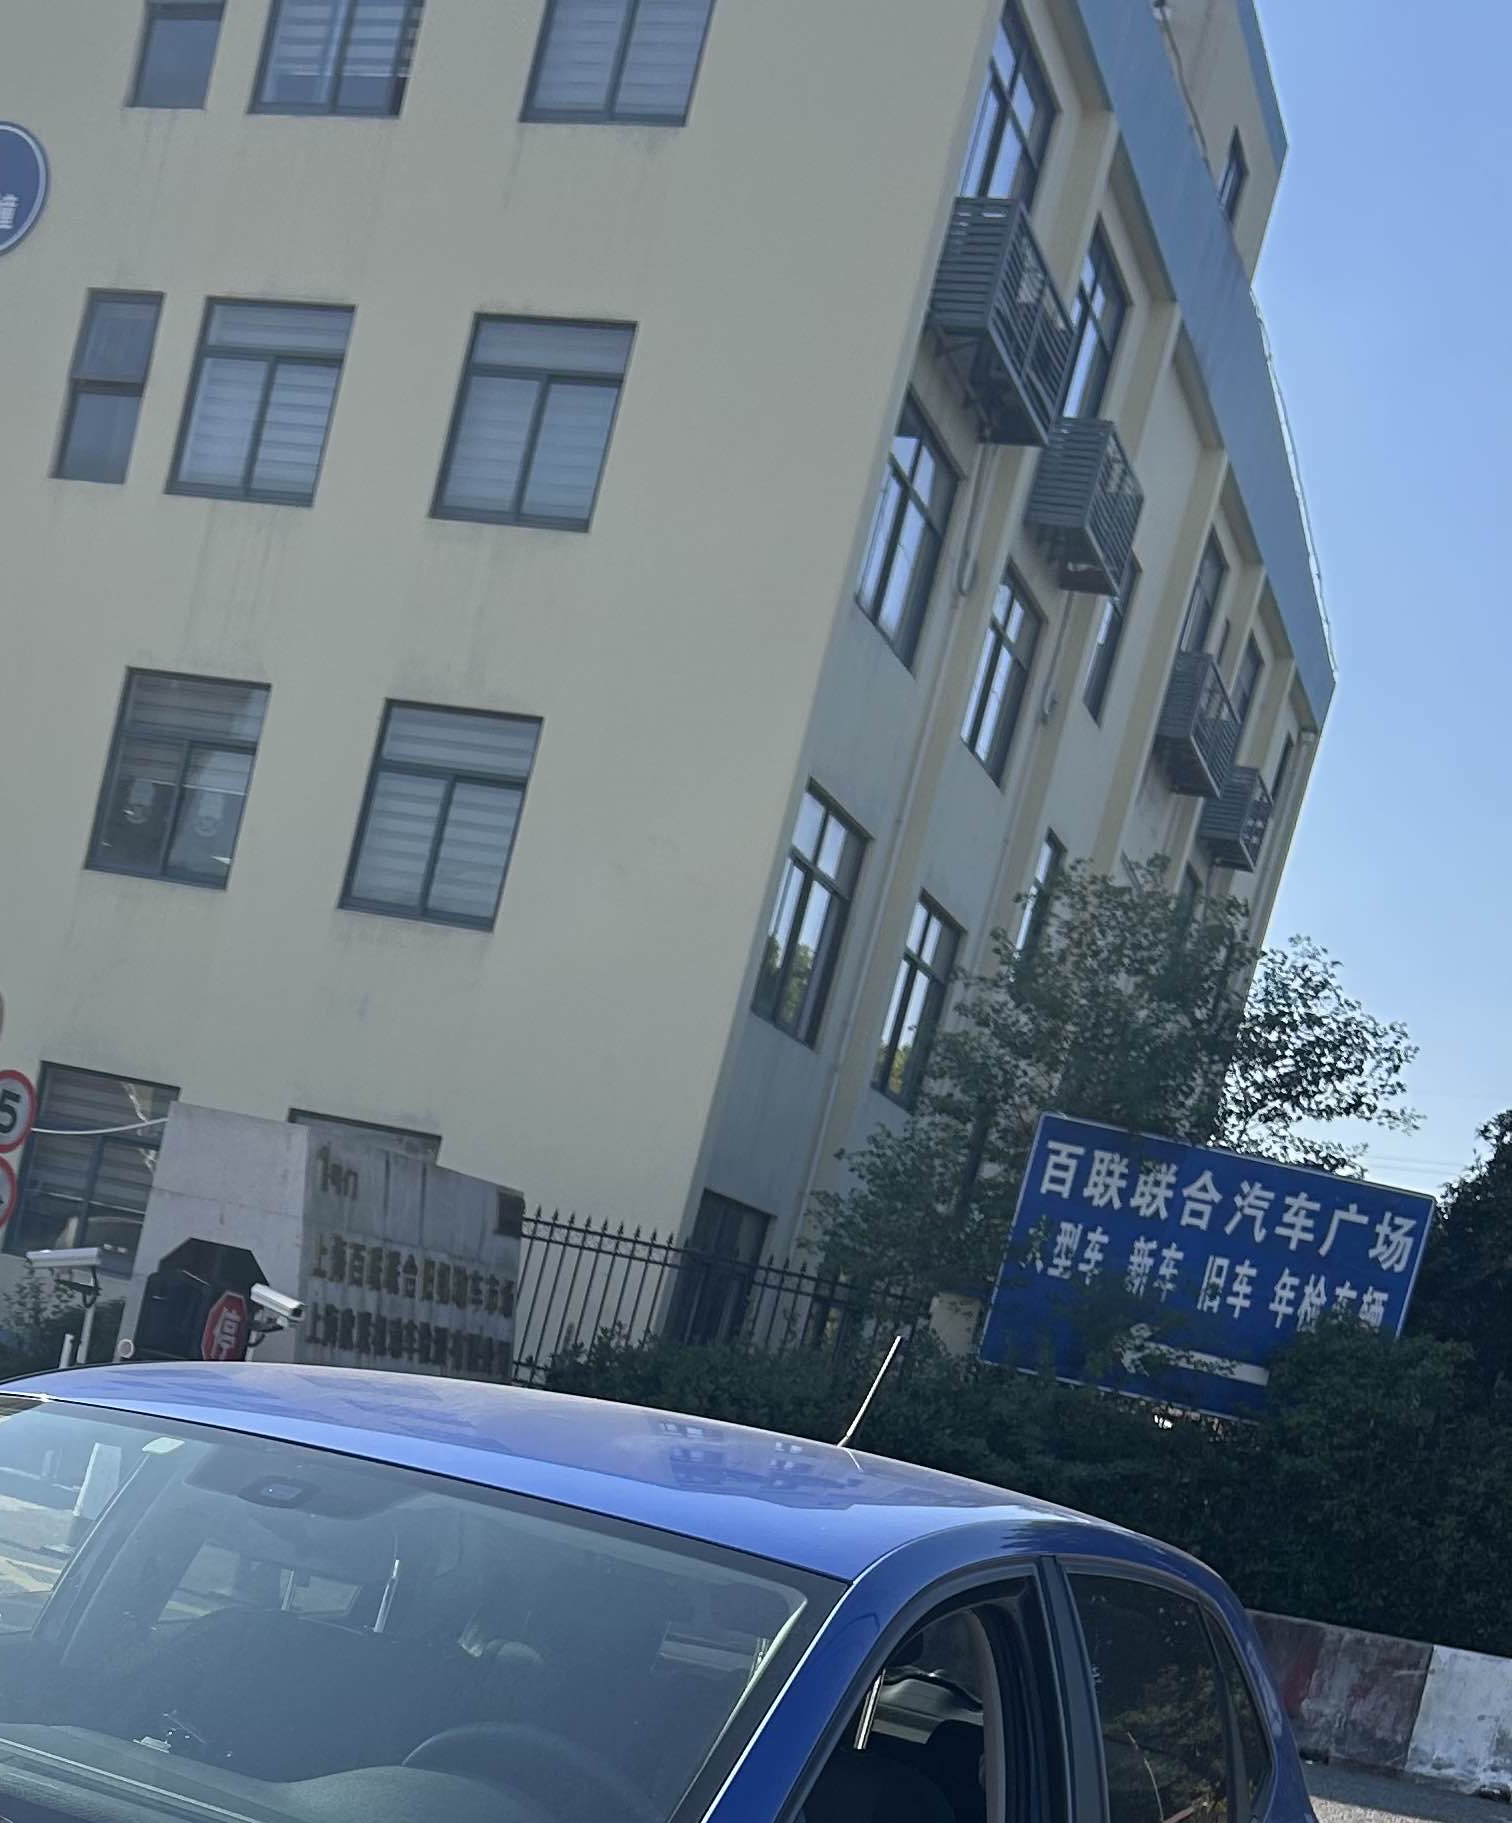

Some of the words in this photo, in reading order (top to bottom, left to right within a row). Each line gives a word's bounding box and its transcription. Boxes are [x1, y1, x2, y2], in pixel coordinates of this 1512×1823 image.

[1039, 1140, 1417, 1274] 百联联合汽车广场
[1196, 1255, 1258, 1319] 旧车
